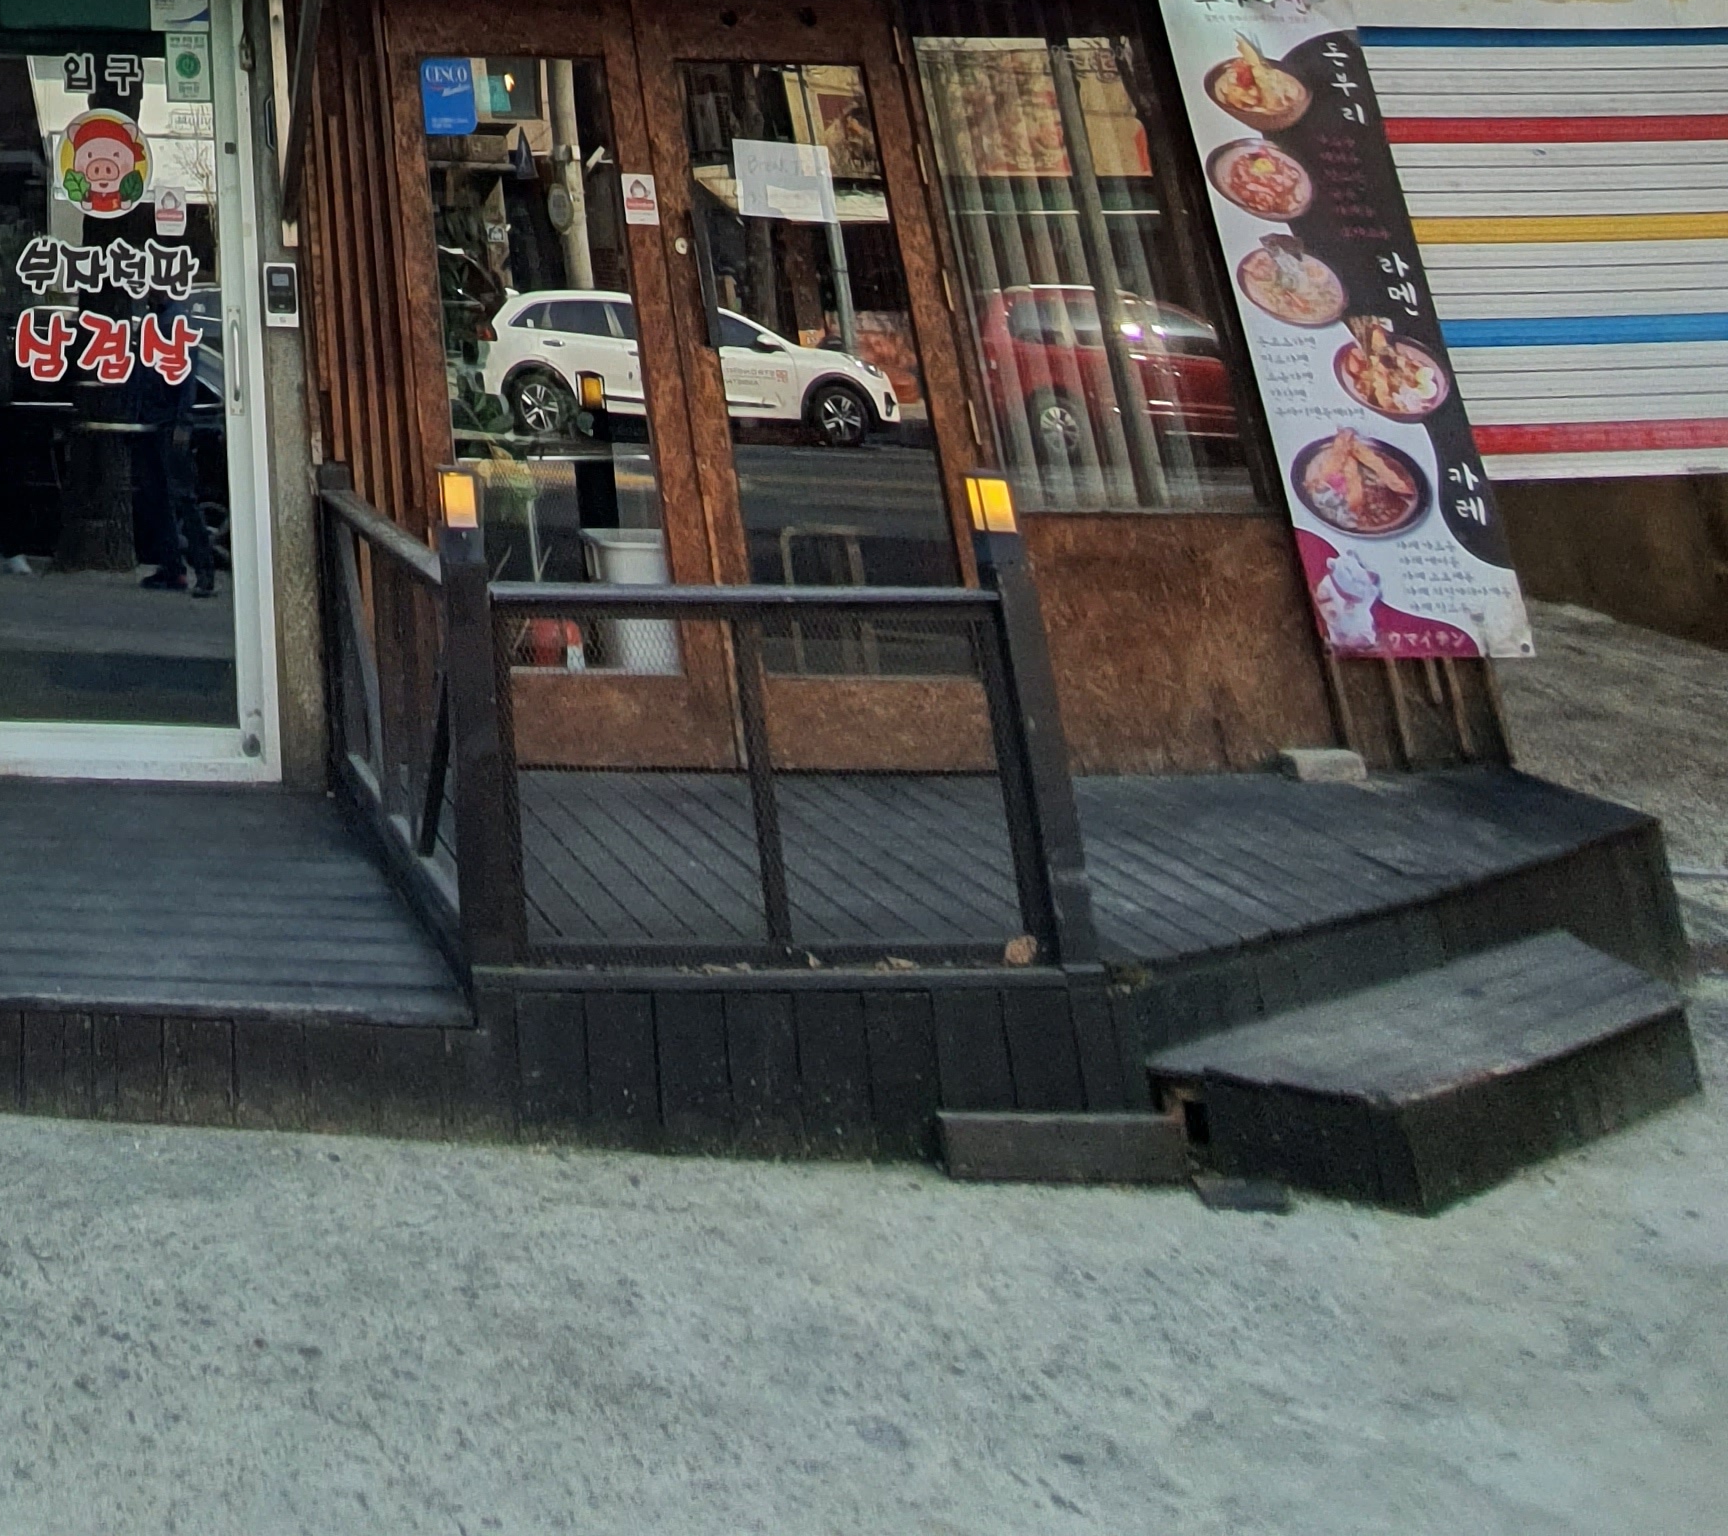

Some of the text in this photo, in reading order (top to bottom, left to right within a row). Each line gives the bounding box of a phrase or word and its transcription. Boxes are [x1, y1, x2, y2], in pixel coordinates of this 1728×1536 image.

[62, 52, 146, 96] 입구
[424, 64, 468, 84] CESCO
[15, 236, 200, 300] 부자철판
[15, 308, 204, 385] 삼겹살
[1447, 461, 1488, 527] 카레
